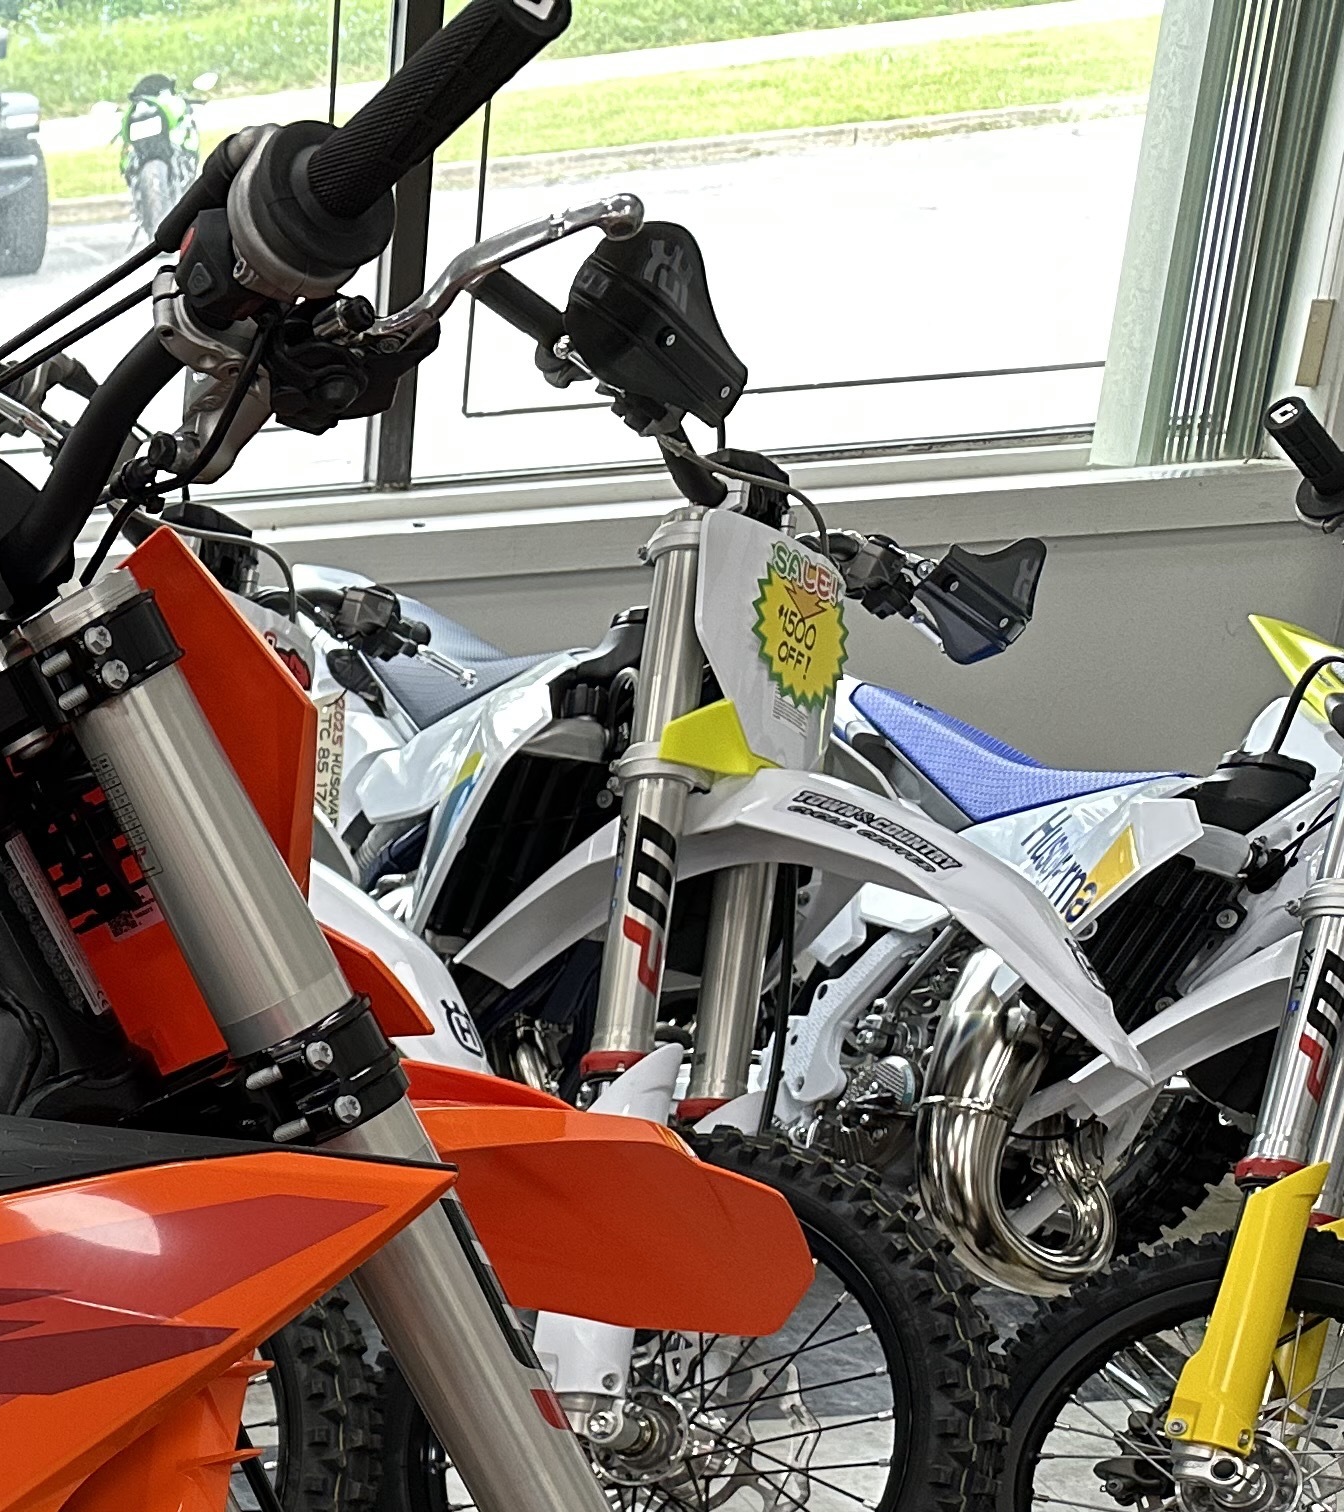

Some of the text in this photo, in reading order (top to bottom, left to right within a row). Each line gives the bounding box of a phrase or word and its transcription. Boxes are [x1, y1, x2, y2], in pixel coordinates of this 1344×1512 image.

[773, 542, 840, 607] SALE!
[778, 604, 817, 651] $1500
[777, 640, 812, 681] OFF!
[333, 699, 346, 747] 2025
[315, 713, 332, 813] TC 85 17/
